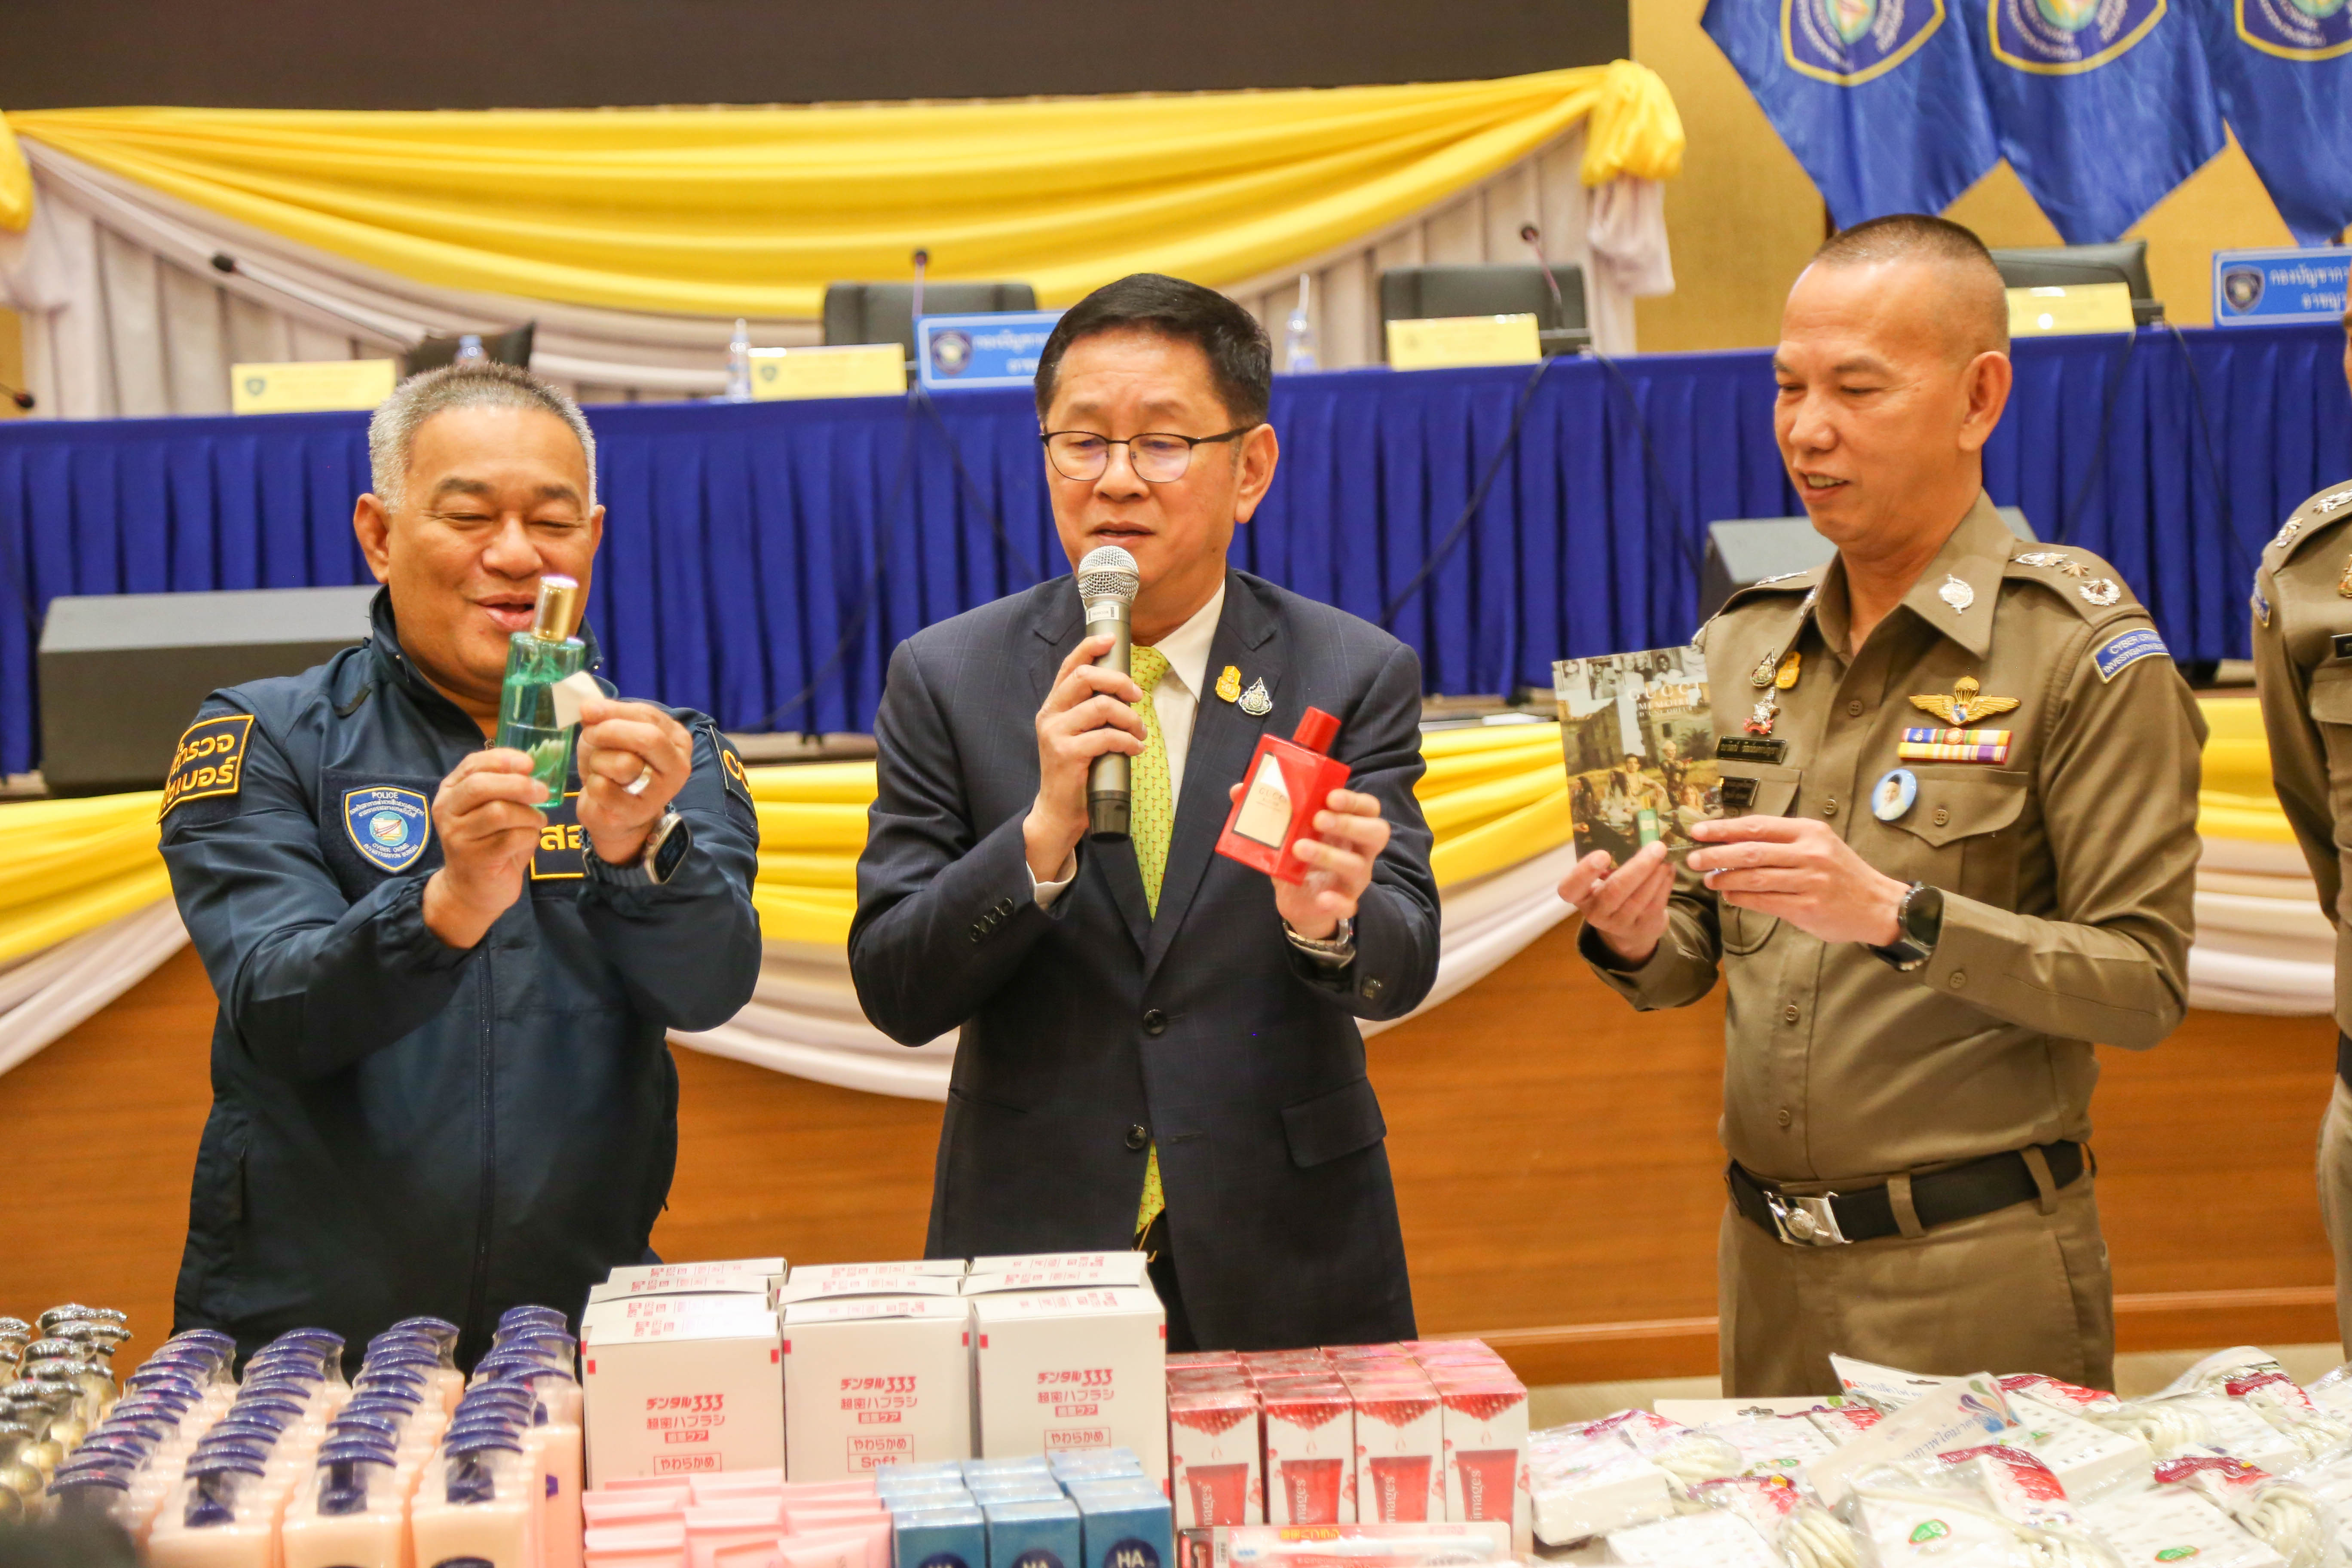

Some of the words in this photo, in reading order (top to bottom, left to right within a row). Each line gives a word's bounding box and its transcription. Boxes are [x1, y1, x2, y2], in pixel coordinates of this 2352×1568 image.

[2109, 636, 2138, 654] CYBER
[1628, 681, 1700, 701] GUCCI
[172, 733, 236, 776] ตำรวจ
[363, 843, 401, 858] INVESTIGATION
[372, 843, 391, 852] CYBER
[393, 842, 410, 853] CRIME
[854, 1438, 906, 1451] やわらかめ
[1051, 1431, 1104, 1445] やわらかめ
[660, 1456, 714, 1471] やわらかめ
[1202, 1485, 1217, 1525] mages
[1296, 1479, 1310, 1525] mages
[1385, 1476, 1400, 1523] mages
